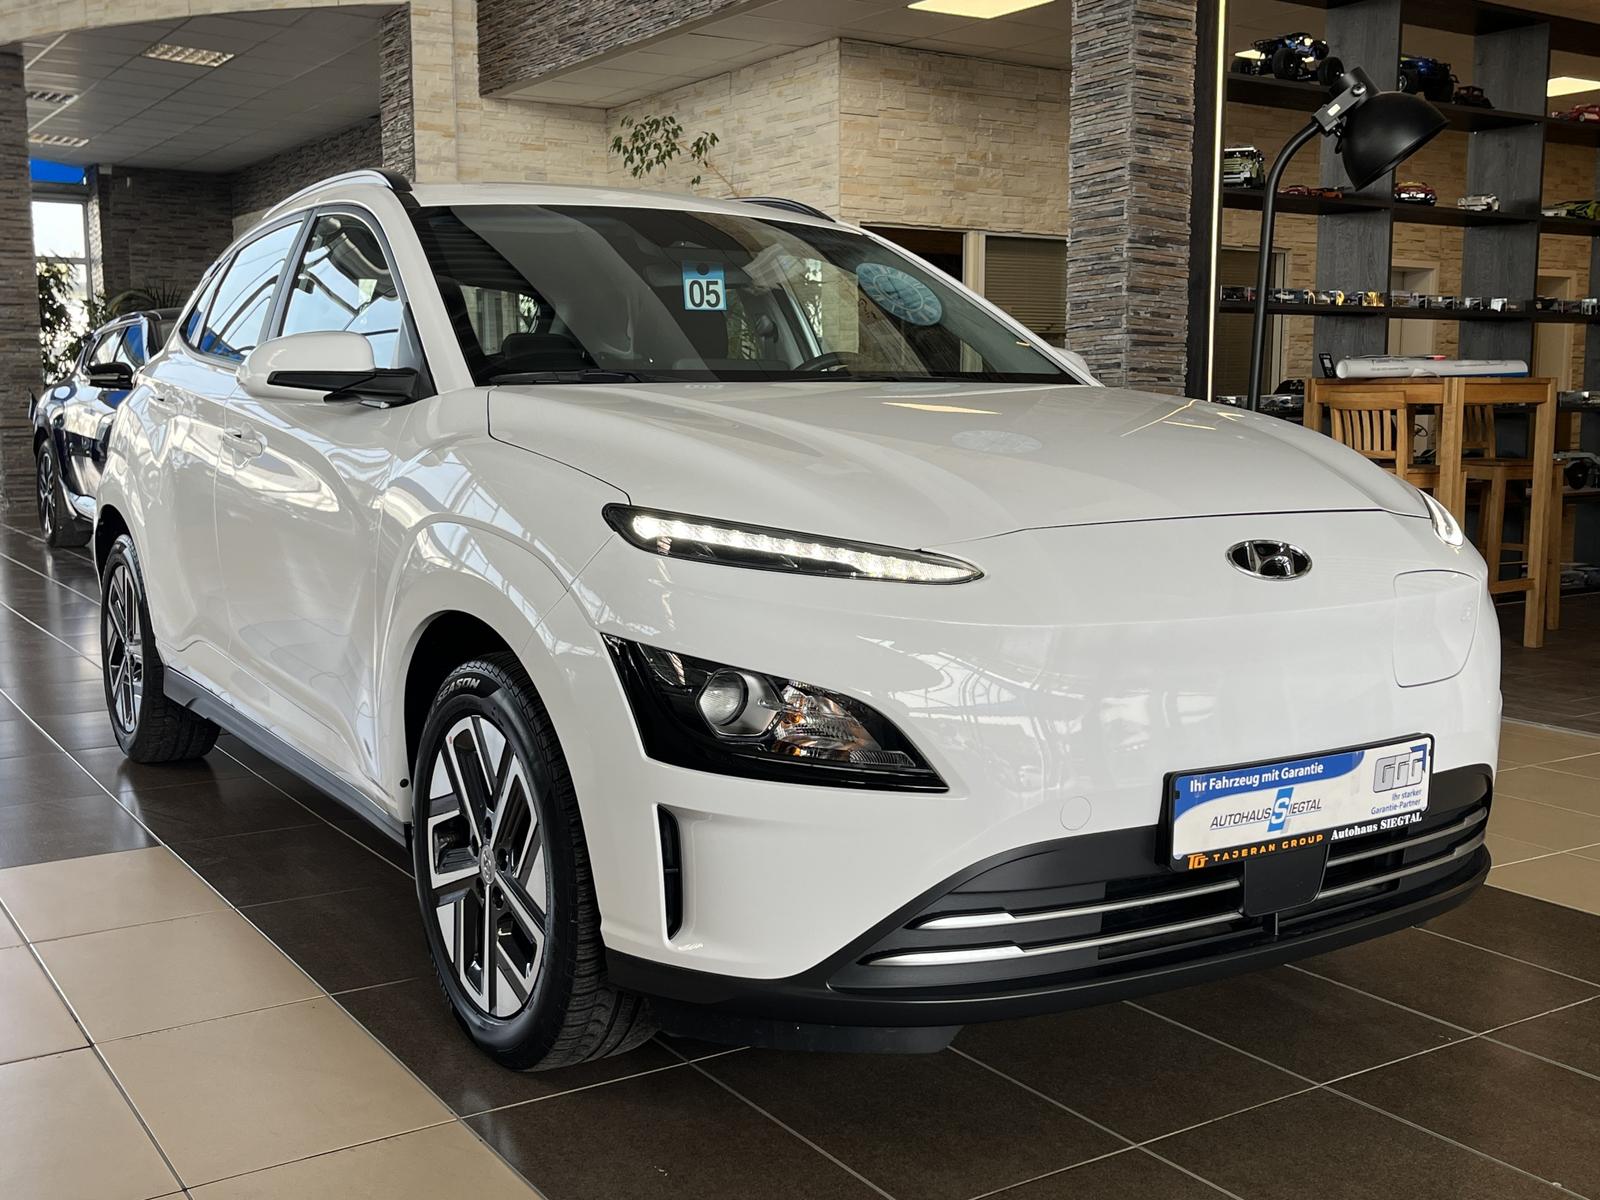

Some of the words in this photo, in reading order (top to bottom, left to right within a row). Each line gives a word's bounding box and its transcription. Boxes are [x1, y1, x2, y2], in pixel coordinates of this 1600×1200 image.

[689, 280, 720, 308] 05
[1190, 780, 1207, 792] Ihr
[1209, 774, 1260, 790] Fahrzeug
[1261, 769, 1279, 783] mit
[1281, 762, 1324, 780] Garantie
[1210, 807, 1272, 828] AUTOHAUS
[1271, 797, 1322, 825] SIEGTAL
[1331, 824, 1378, 840] Autohaus
[1380, 812, 1422, 830] SIEGTAL
[1213, 843, 1277, 862] TAJERAN
[1281, 834, 1324, 849] GROUP
